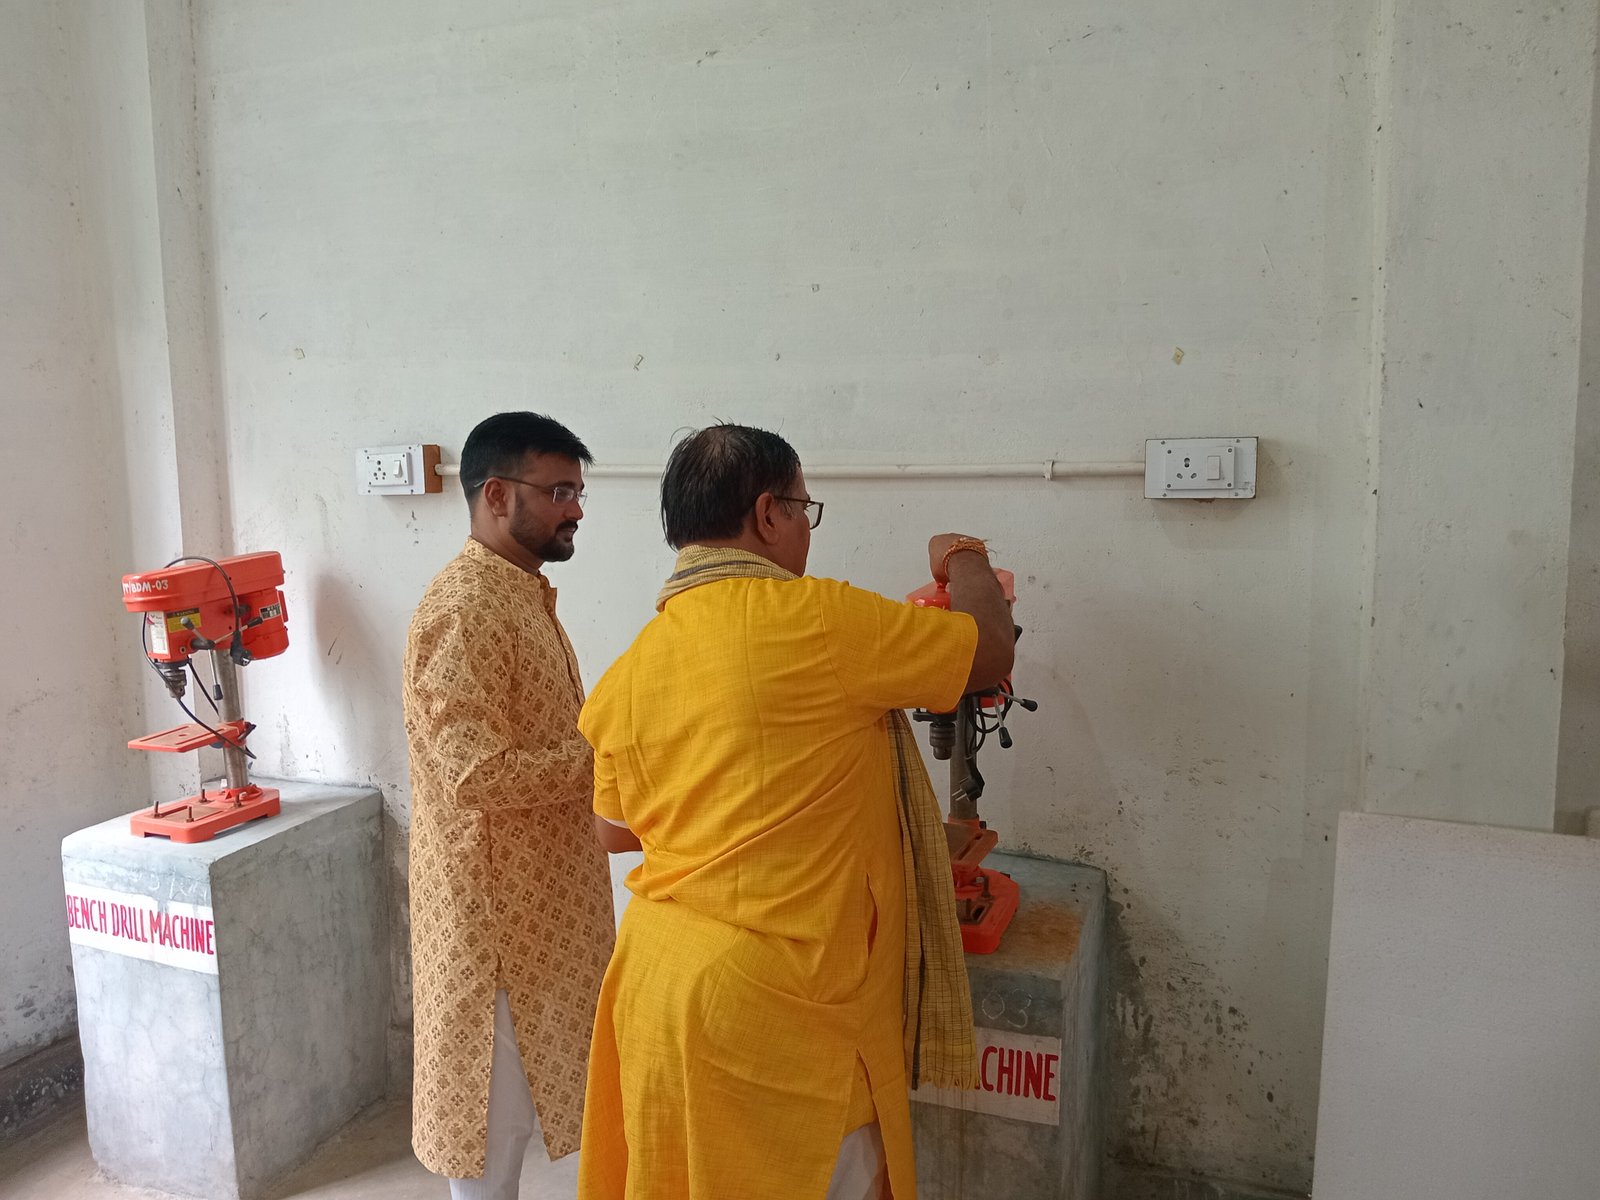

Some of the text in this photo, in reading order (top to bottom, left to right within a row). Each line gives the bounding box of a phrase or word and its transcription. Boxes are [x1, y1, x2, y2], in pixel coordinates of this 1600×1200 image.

[67, 894, 214, 955] BENCH DRILL MACHINE
[975, 1046, 1059, 1101] CHINE
